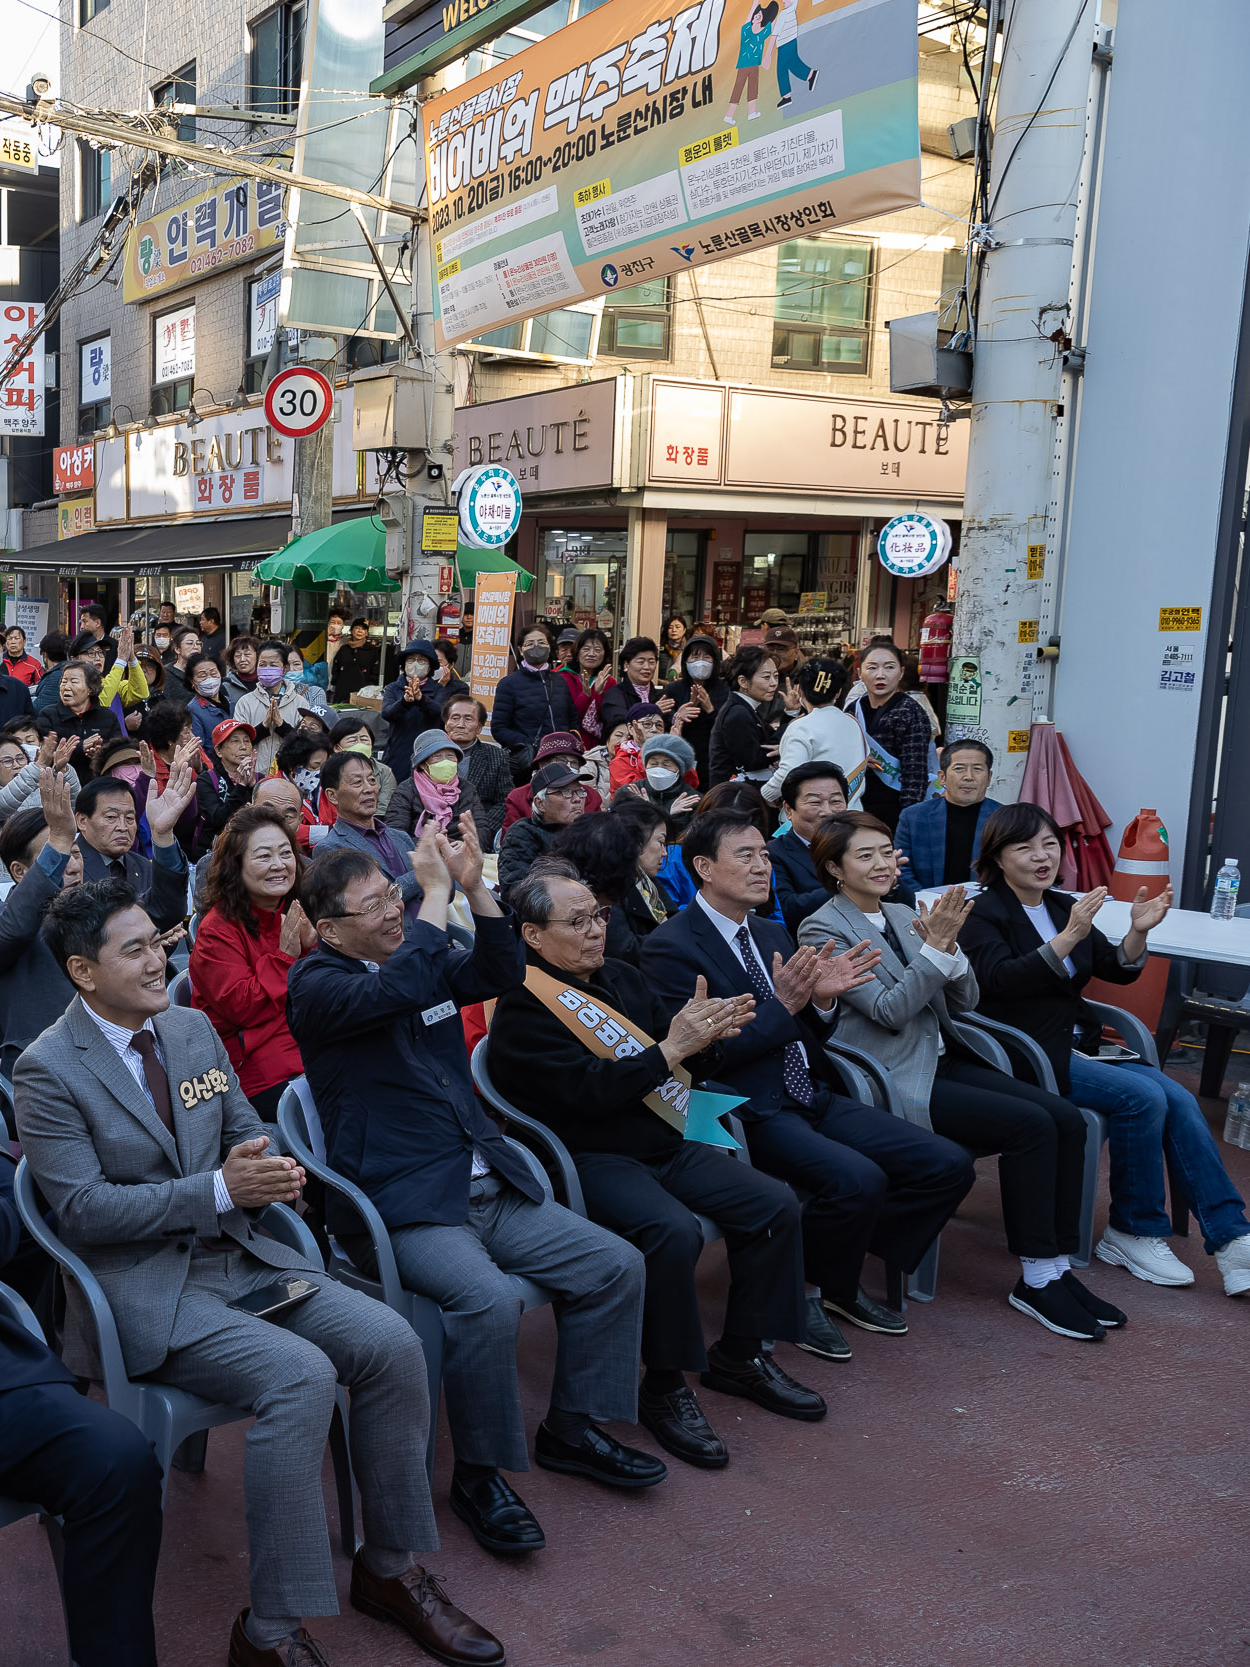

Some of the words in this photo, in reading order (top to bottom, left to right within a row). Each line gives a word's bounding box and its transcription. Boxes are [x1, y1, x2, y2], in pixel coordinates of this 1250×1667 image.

[428, 69, 524, 149] 노룬산골목시장
[429, 88, 541, 206] 비어비워
[542, 0, 726, 135] 맥주축제
[467, 172, 505, 215] 20(금)
[507, 128, 597, 193] 16:00~20:00
[600, 86, 689, 150] 노룬산시장
[692, 73, 714, 109] 내
[684, 140, 711, 163] 행운의
[802, 138, 839, 160] 제기차기
[687, 164, 730, 187] 온누리상품권
[577, 188, 591, 203] 축하
[592, 183, 606, 198] 행사
[167, 165, 282, 267] 인력개발
[698, 200, 837, 255] 노룬산골목시장상인회
[140, 237, 153, 275] 량
[190, 235, 255, 274] 02)462-7082
[619, 256, 655, 277] 광진구
[90, 348, 104, 385] 량
[279, 389, 317, 417] 30
[4, 419, 19, 428] 맥주
[21, 419, 38, 428] 양주
[469, 409, 591, 467] BEAUTÉ
[666, 444, 710, 467] 화장품
[880, 461, 901, 478] 보떼
[518, 464, 540, 481] 보떼
[197, 470, 261, 504] 화장품
[139, 565, 162, 576] BEAUTÉ
[1161, 670, 1195, 684] 김고철
[180, 1067, 230, 1109] 오신환
